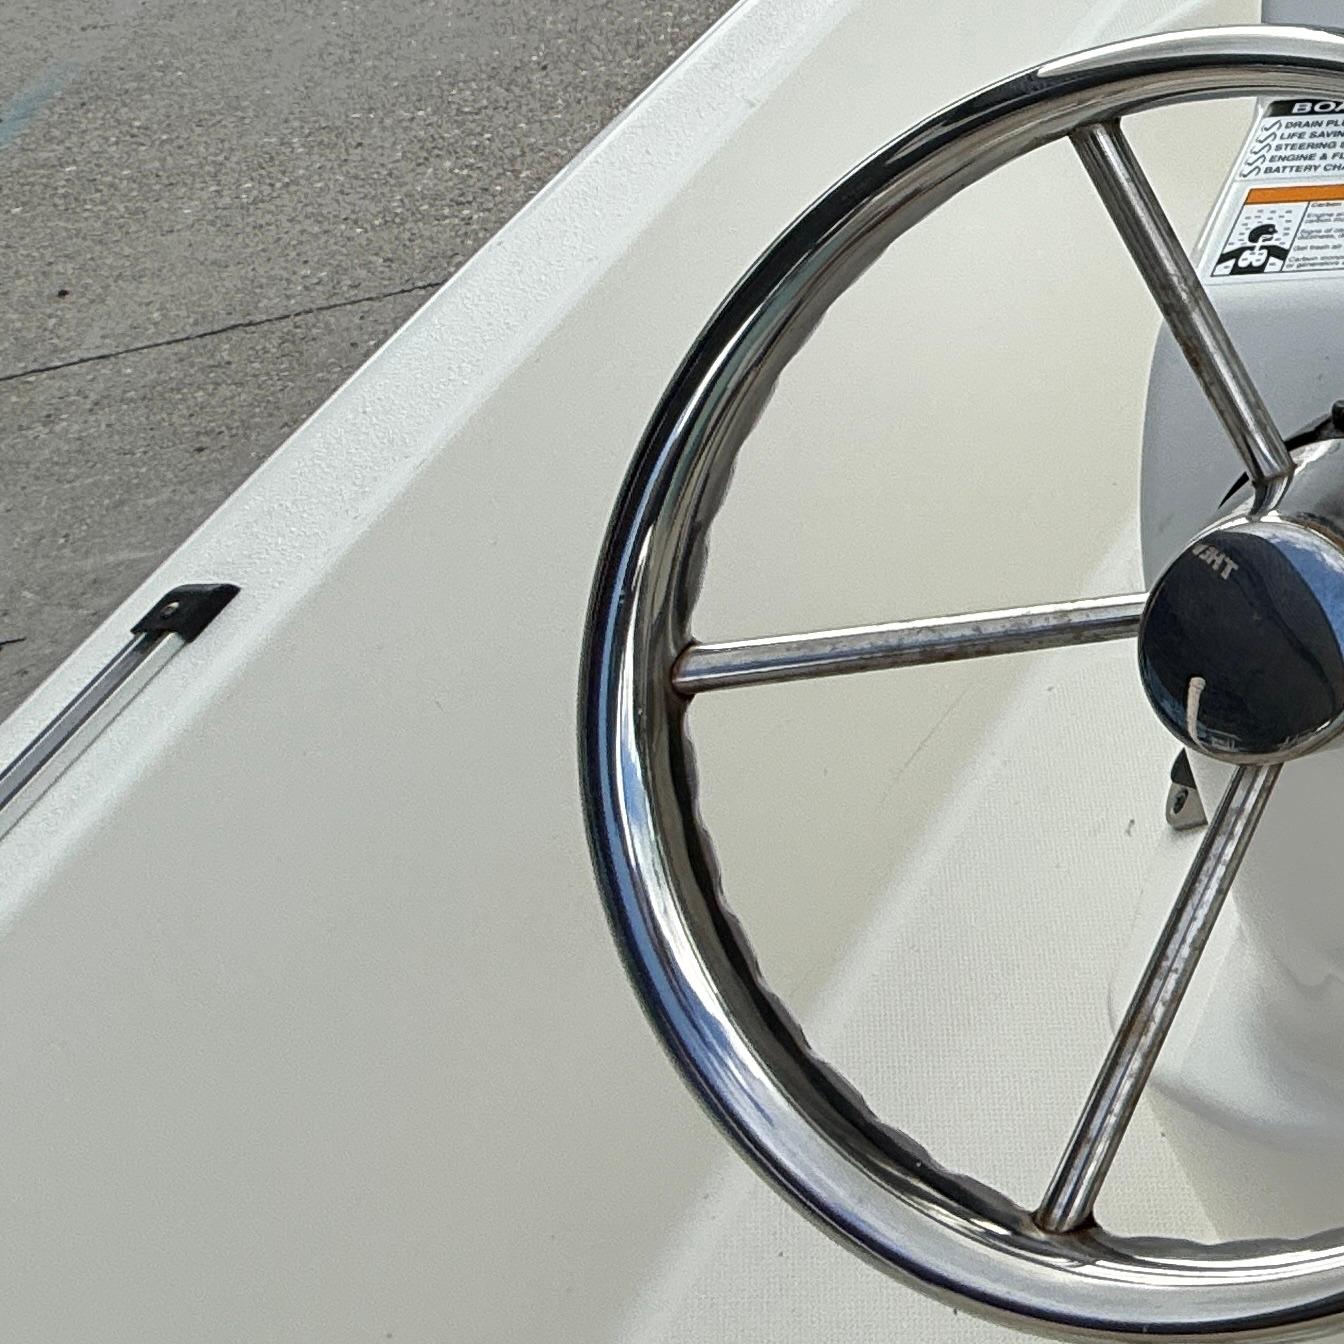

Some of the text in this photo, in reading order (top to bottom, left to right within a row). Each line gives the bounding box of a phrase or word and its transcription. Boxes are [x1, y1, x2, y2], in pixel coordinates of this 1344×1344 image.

[1284, 120, 1324, 130] DRAIN
[1279, 131, 1306, 141] LIFE
[1274, 141, 1336, 152] STEERING
[1268, 152, 1316, 164] ENGINE
[1263, 164, 1321, 175] BATTERY
